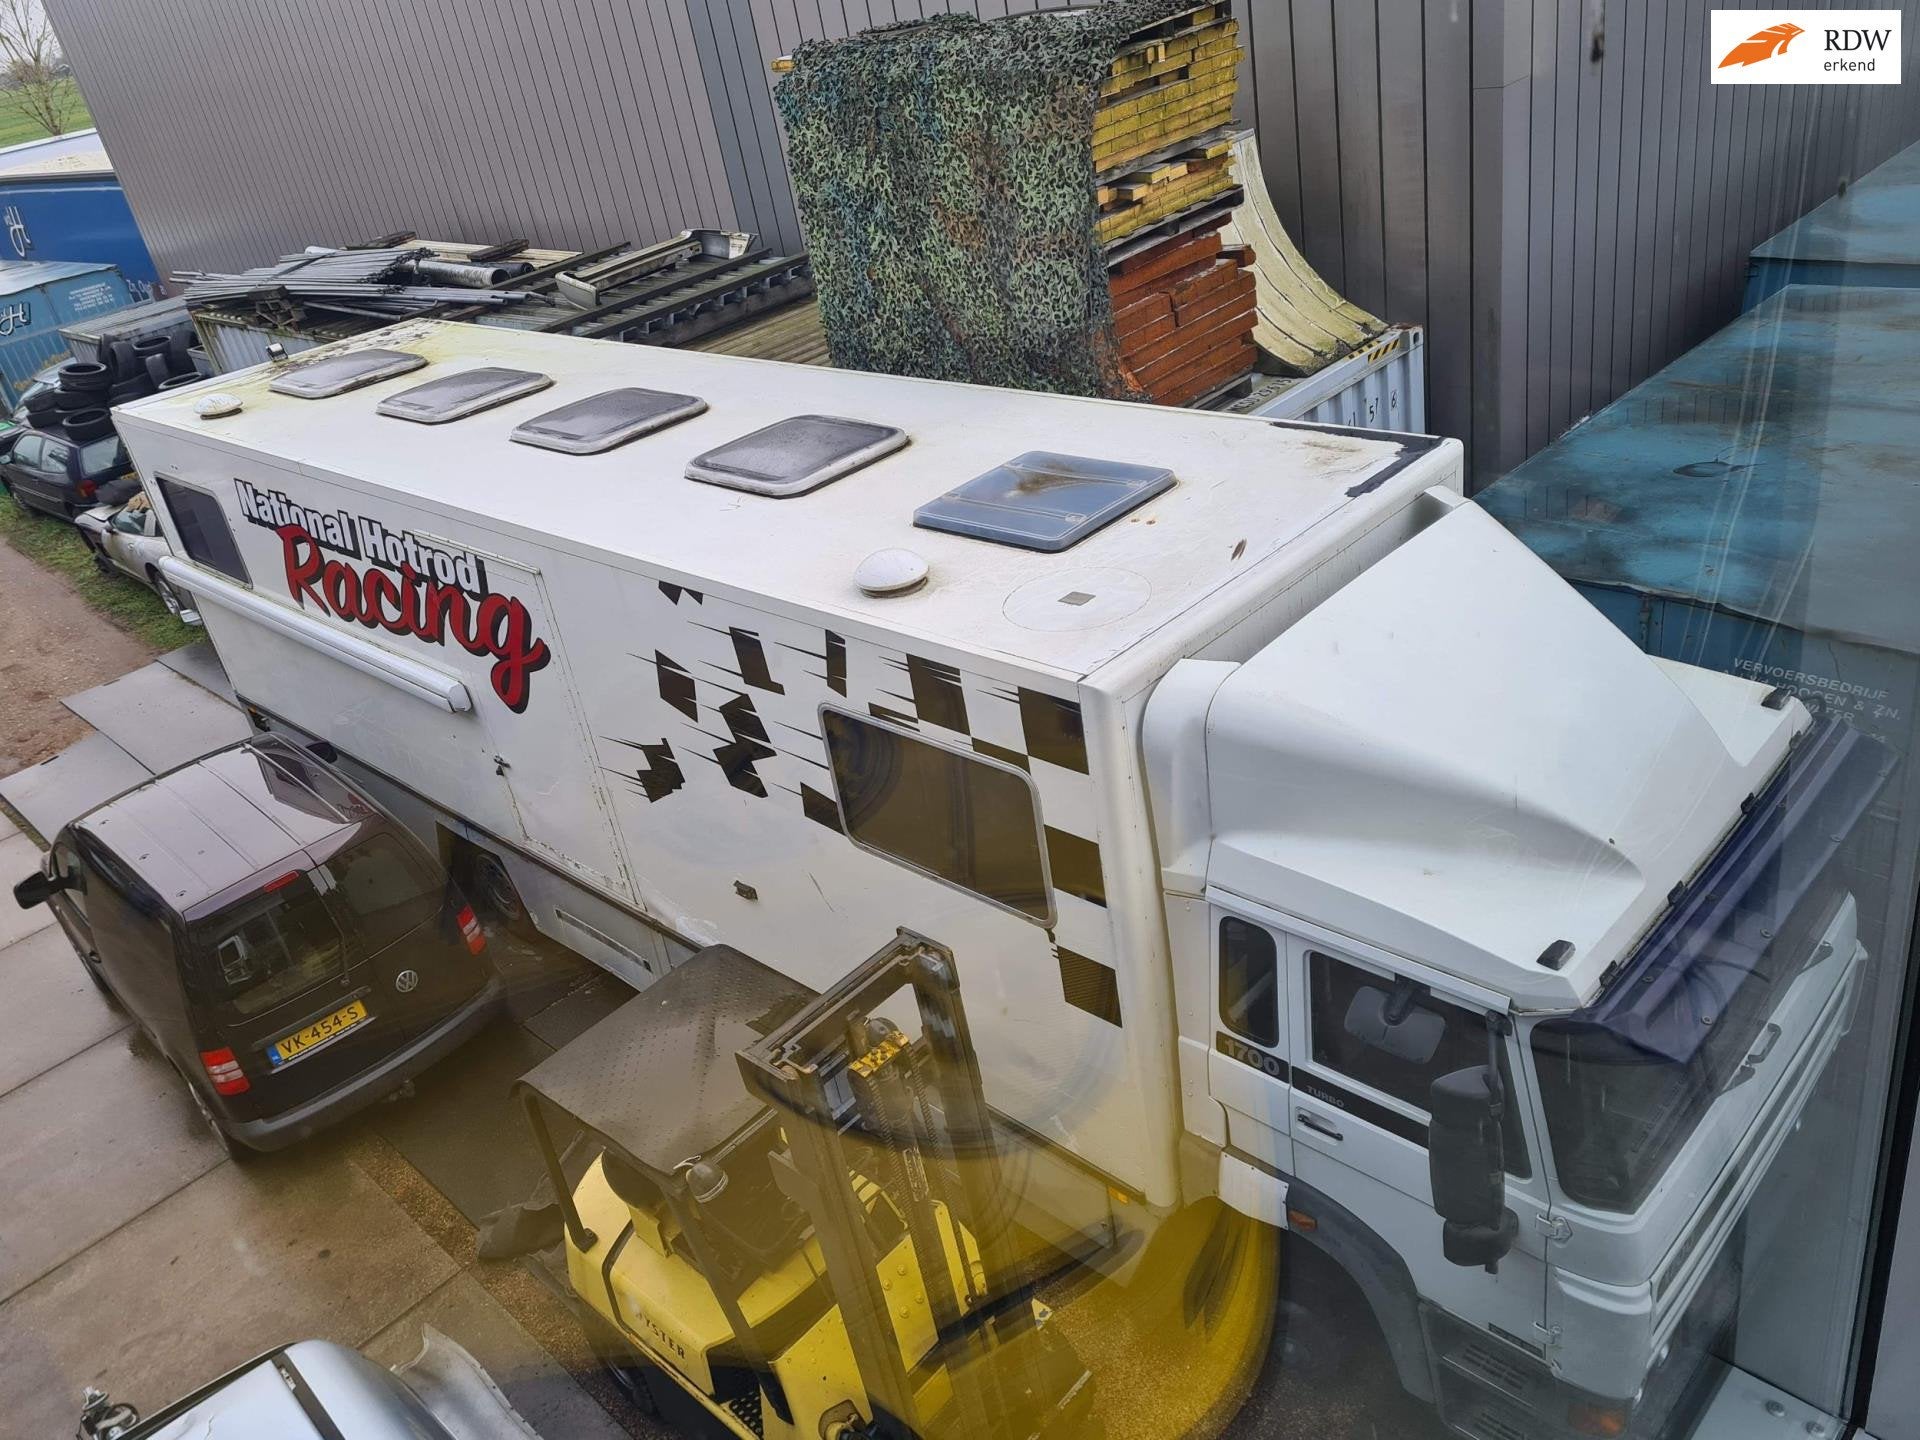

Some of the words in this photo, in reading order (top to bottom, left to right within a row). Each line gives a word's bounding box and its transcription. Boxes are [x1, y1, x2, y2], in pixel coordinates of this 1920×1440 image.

[234, 478, 361, 560] National
[357, 515, 489, 600] Hotrod
[276, 523, 551, 714] Racing
[1734, 657, 1888, 699] VERVOERSBEDRIJF
[280, 1006, 359, 1053] VK-454-S
[1224, 1039, 1280, 1076] 1700
[1306, 1085, 1345, 1108] TURBO
